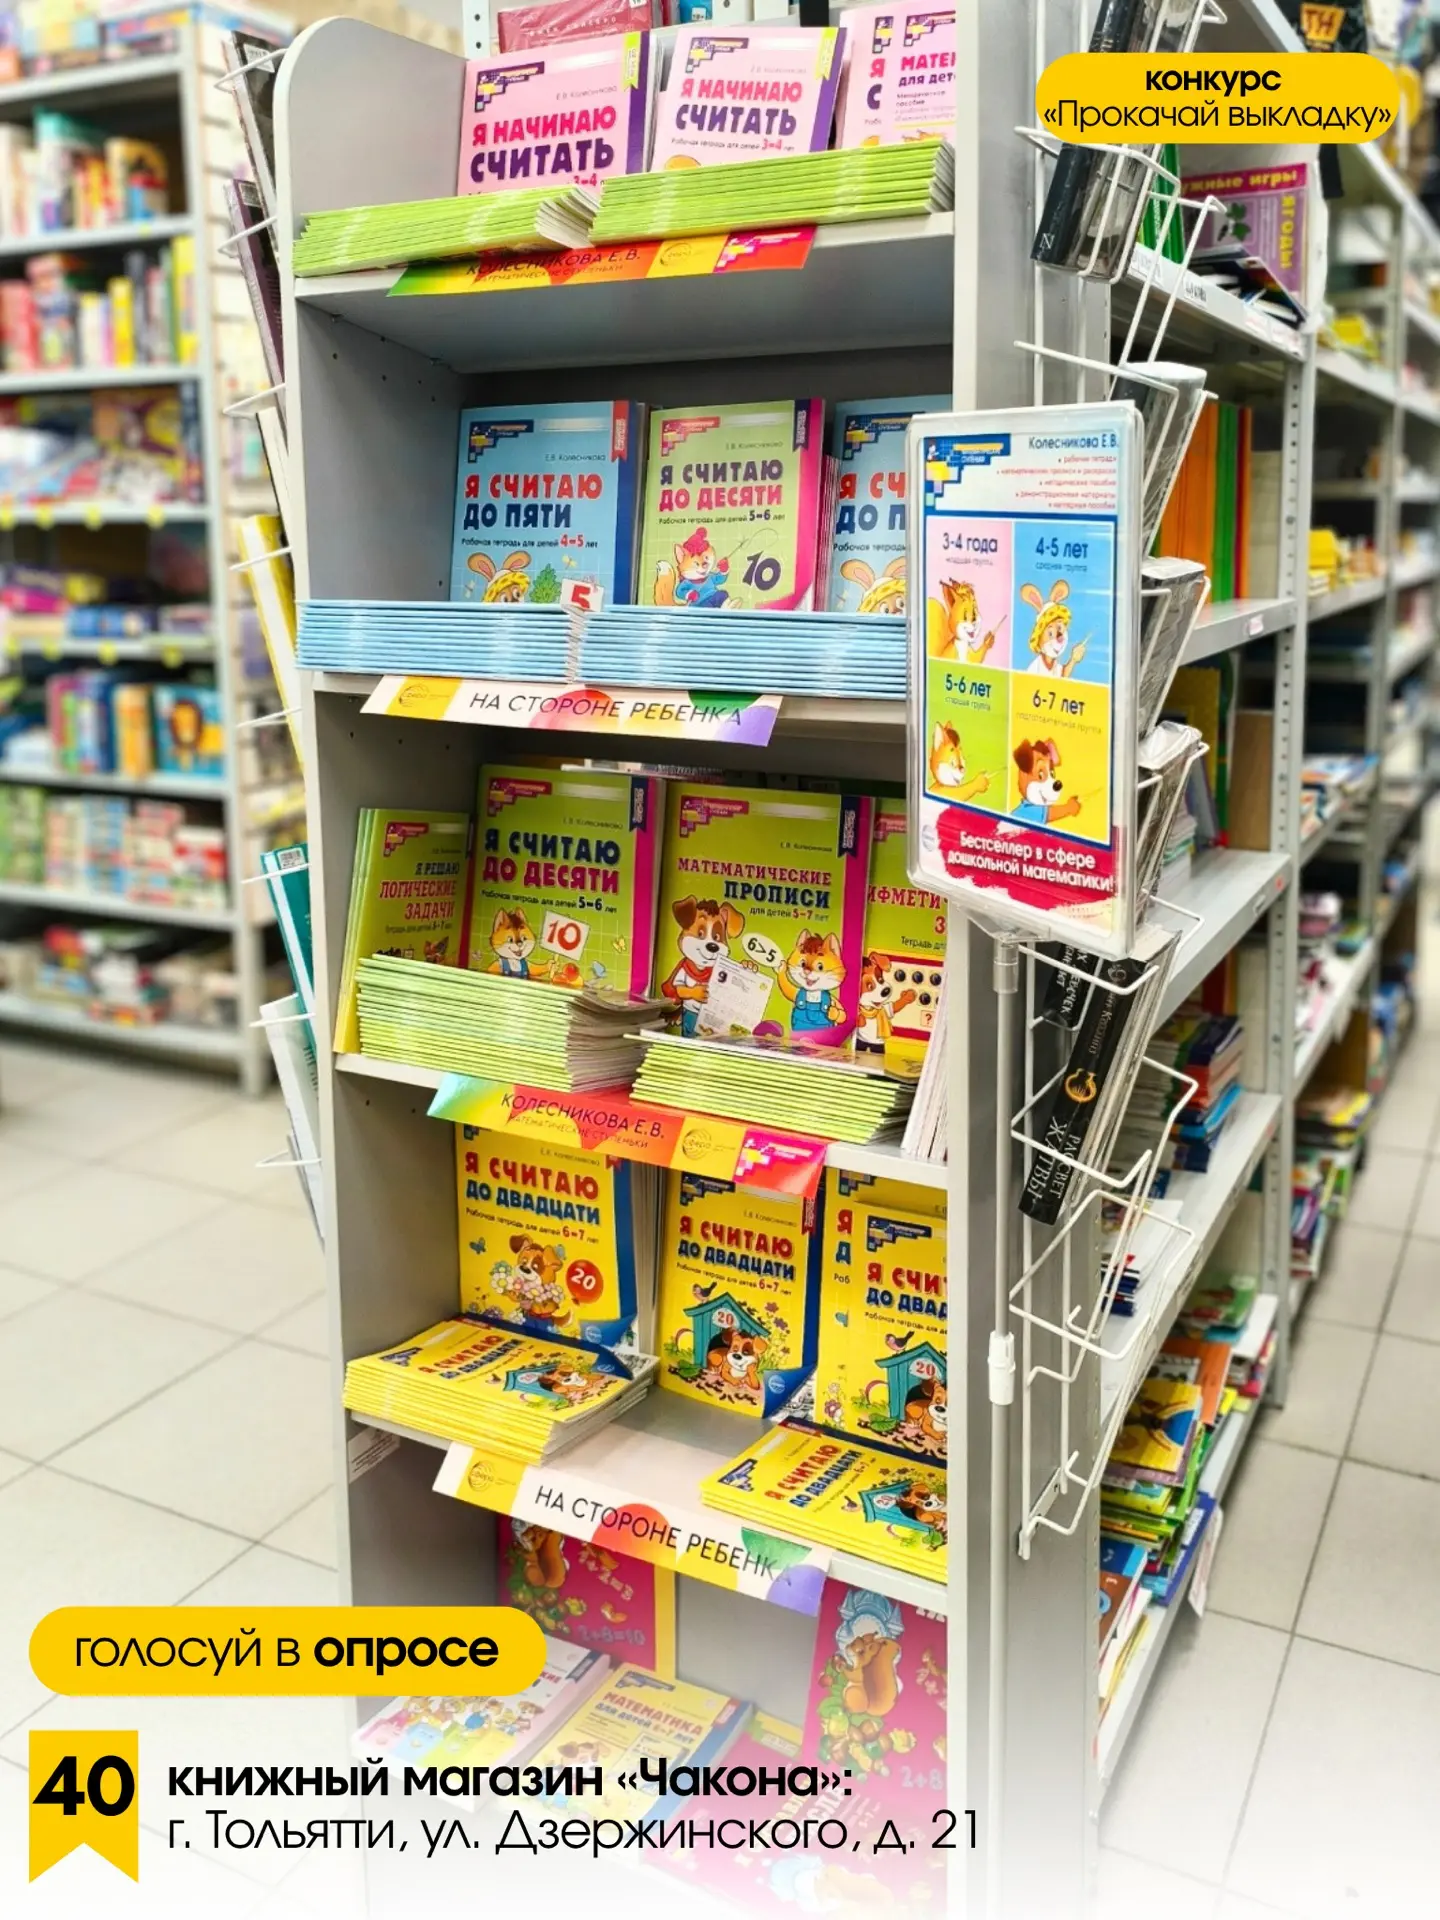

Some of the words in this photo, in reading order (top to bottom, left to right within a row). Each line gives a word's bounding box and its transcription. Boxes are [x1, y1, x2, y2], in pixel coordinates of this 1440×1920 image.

[869, 58, 885, 78] Я
[898, 75, 925, 88] для
[681, 78, 695, 97] Я
[697, 79, 803, 104] НАЧИНАЮ
[472, 123, 488, 147] Я
[493, 105, 617, 143] НАЧИНАЮ
[675, 104, 797, 136] СЧИТАТЬ
[470, 137, 615, 183] СЧИТАТЬ
[1249, 170, 1297, 188] игры
[1028, 436, 1098, 449] Колесникова
[1101, 433, 1119, 448] Е.В.
[559, 453, 606, 462] Колесникова
[465, 474, 479, 499] Я
[489, 473, 603, 500] СЧИТАЮ
[660, 465, 673, 486] Я
[682, 459, 784, 484] СЧИТАЮ
[839, 473, 857, 500] Я
[658, 489, 690, 513] ДО
[697, 484, 783, 511] ДЕСЯТИ
[463, 503, 498, 531] ДО
[505, 503, 571, 529] ПЯТИ
[835, 504, 878, 535] ДО
[461, 537, 491, 546] Рабочая
[493, 538, 521, 547] тетрадь
[585, 541, 598, 549] лет
[833, 543, 870, 552] Рабочая
[942, 532, 963, 551] 3-4
[966, 537, 998, 554] года
[1035, 536, 1059, 557] 4-5
[1062, 543, 1089, 560] лет
[743, 550, 782, 592] 10
[571, 585, 591, 609] 5
[945, 673, 966, 694] 5-6
[969, 681, 992, 699] лет
[469, 692, 500, 710] НА
[508, 695, 622, 718] СТОРОНЕ
[629, 701, 742, 727] РЕБЕНКА
[1032, 689, 1057, 711] 6-7
[1060, 698, 1086, 717] лет
[484, 828, 499, 853] Я
[508, 829, 621, 866] СЧИТАЮ
[959, 831, 1032, 861] Бестселлер
[1035, 847, 1043, 860] в
[1046, 847, 1095, 870] сфере
[482, 856, 518, 883] ДО
[523, 860, 620, 896] ДЕСЯТИ
[677, 857, 832, 887] МАТЕМАТИЧЕСКИЕ
[947, 850, 1019, 876] дошкольной
[1022, 864, 1114, 892] математики!
[379, 880, 457, 899] ЛОГИЧЕСКИЕ
[724, 880, 830, 909] ПРОПИСИ
[868, 885, 948, 909] ИФМЕТИ
[405, 901, 455, 921] ЗАДАЧИ
[750, 906, 765, 916] для
[767, 909, 791, 918] детей
[792, 908, 813, 920] 5-7
[546, 919, 582, 951] 10
[901, 936, 932, 949] Тетрадь
[717, 970, 728, 983] 9
[501, 1093, 629, 1132] КОЛЕСНИКОВА
[633, 1118, 665, 1139] Е.В.
[1027, 1116, 1068, 1199] ЖАТВЫ
[464, 1151, 479, 1174] Я
[488, 1157, 599, 1200] СЧИТАЮ
[466, 1179, 492, 1201] ДО
[496, 1186, 601, 1226] ДВАДЦАТИ
[837, 1208, 853, 1235] Я
[679, 1215, 692, 1235] Я
[700, 1220, 793, 1259] СЧИТАЮ
[678, 1240, 701, 1258] ДО
[704, 1246, 796, 1282] ДВАДЦАТИ
[570, 1267, 597, 1291] 20
[867, 1262, 883, 1284] Я
[891, 1267, 947, 1300] СЧИ
[866, 1287, 894, 1307] ДО
[717, 1311, 735, 1326] 20
[434, 1335, 504, 1368] СЧИТАЮ
[916, 1360, 936, 1376] 20
[764, 1490, 786, 1500] Я
[777, 1445, 841, 1490] СЧИТАЮ
[789, 1494, 812, 1507] ДО
[805, 1449, 862, 1496] ДВАДЦАТИ
[535, 1485, 565, 1513] НА
[571, 1498, 678, 1551] СТОРОНЕ
[595, 1703, 615, 1716] для
[618, 1711, 652, 1729] детей
[602, 1691, 703, 1736] МАТЕМАТИКА
